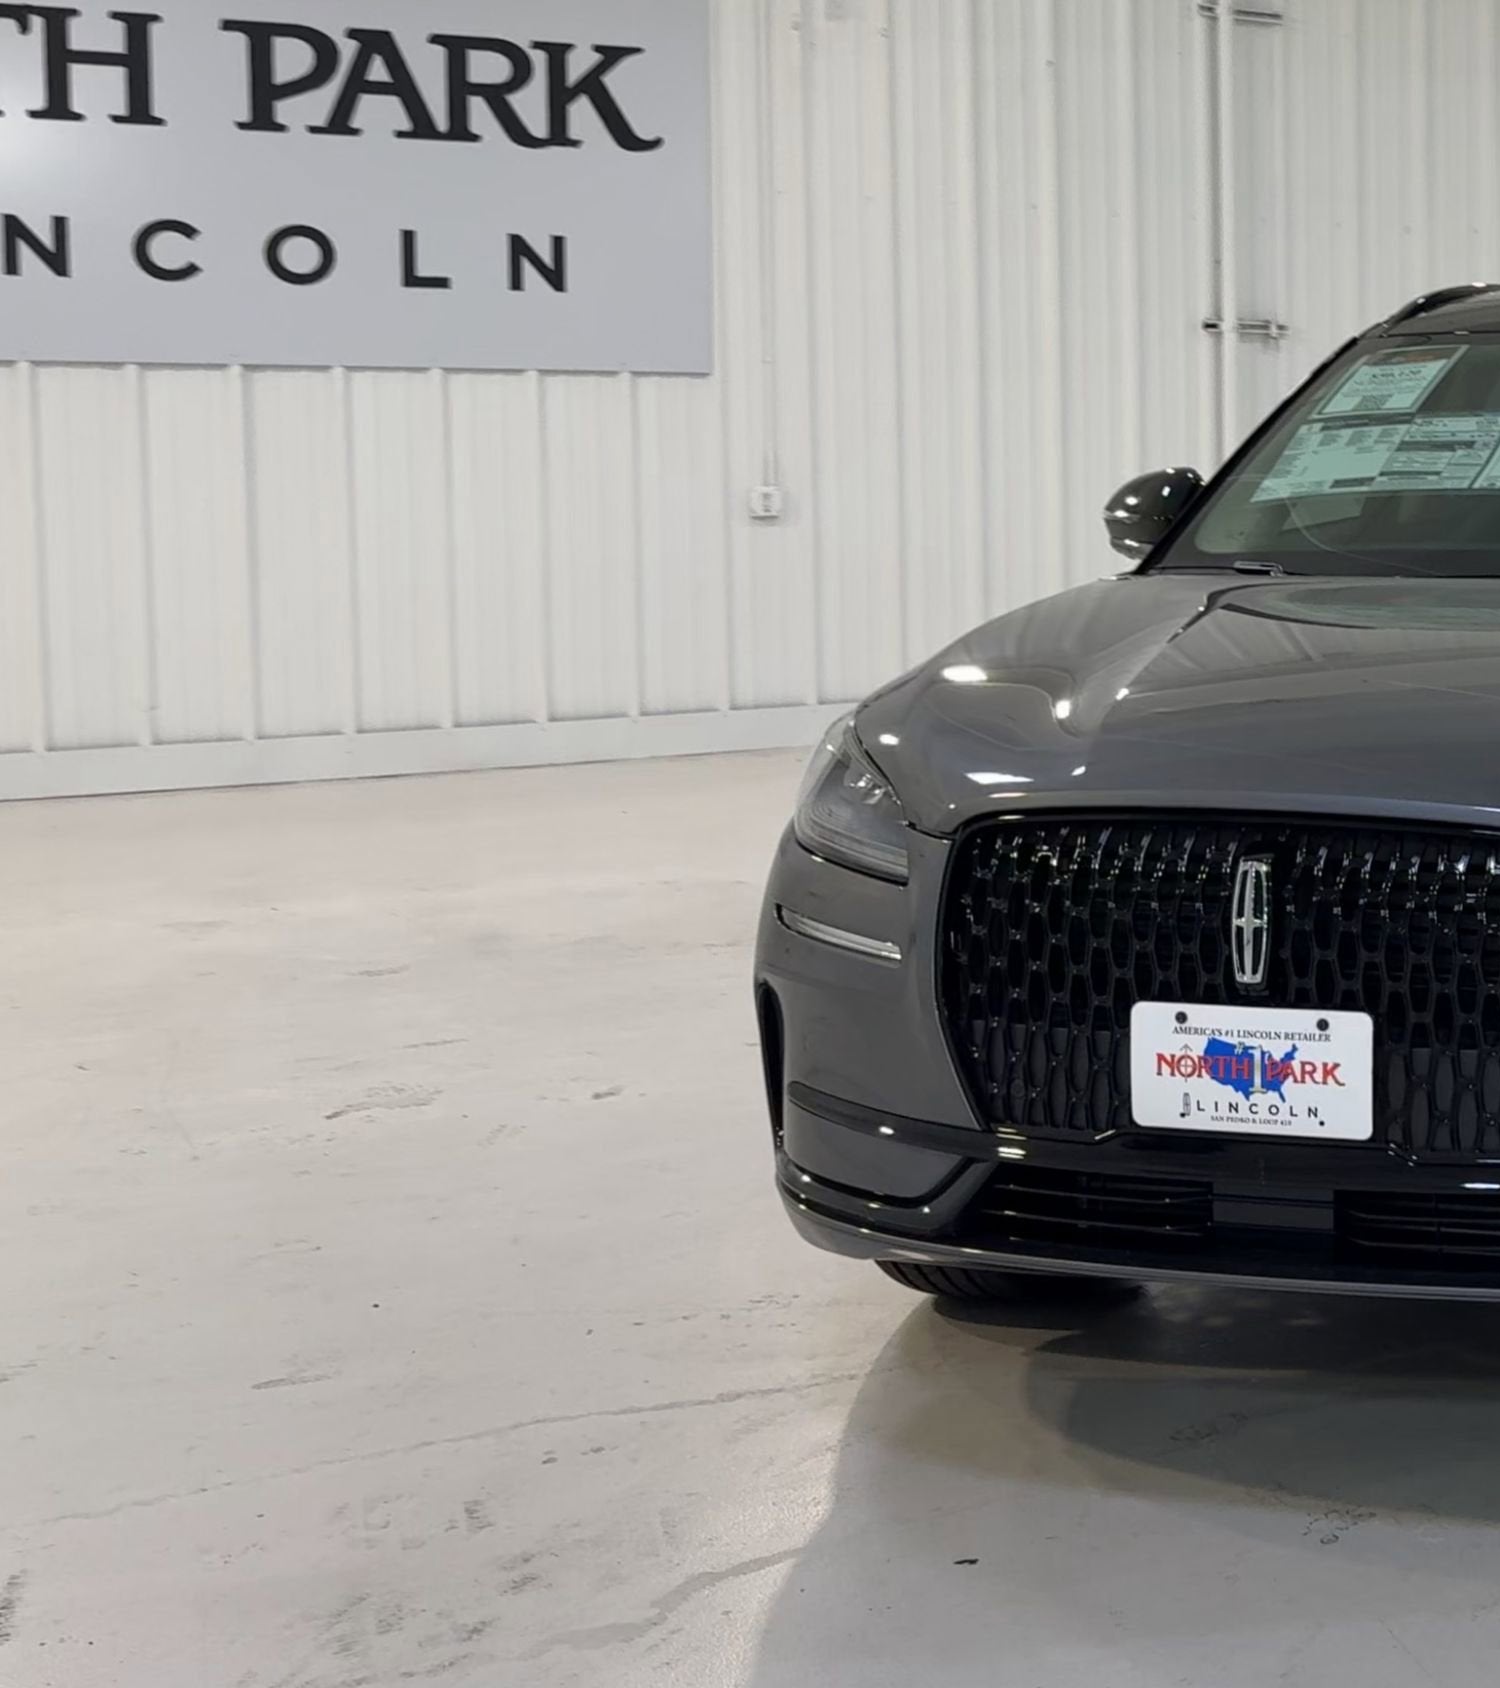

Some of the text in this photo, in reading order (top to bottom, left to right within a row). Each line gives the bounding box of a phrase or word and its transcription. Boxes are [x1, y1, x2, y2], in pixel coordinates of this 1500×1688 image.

[218, 18, 665, 153] PARK
[1172, 1025, 1332, 1043] AMERICA'S #1 LINCOLN RETAILER
[1156, 1052, 1346, 1087] NORTH PARK
[1196, 1099, 1319, 1119] LINCOLN
[1210, 1115, 1225, 1123] SAN
